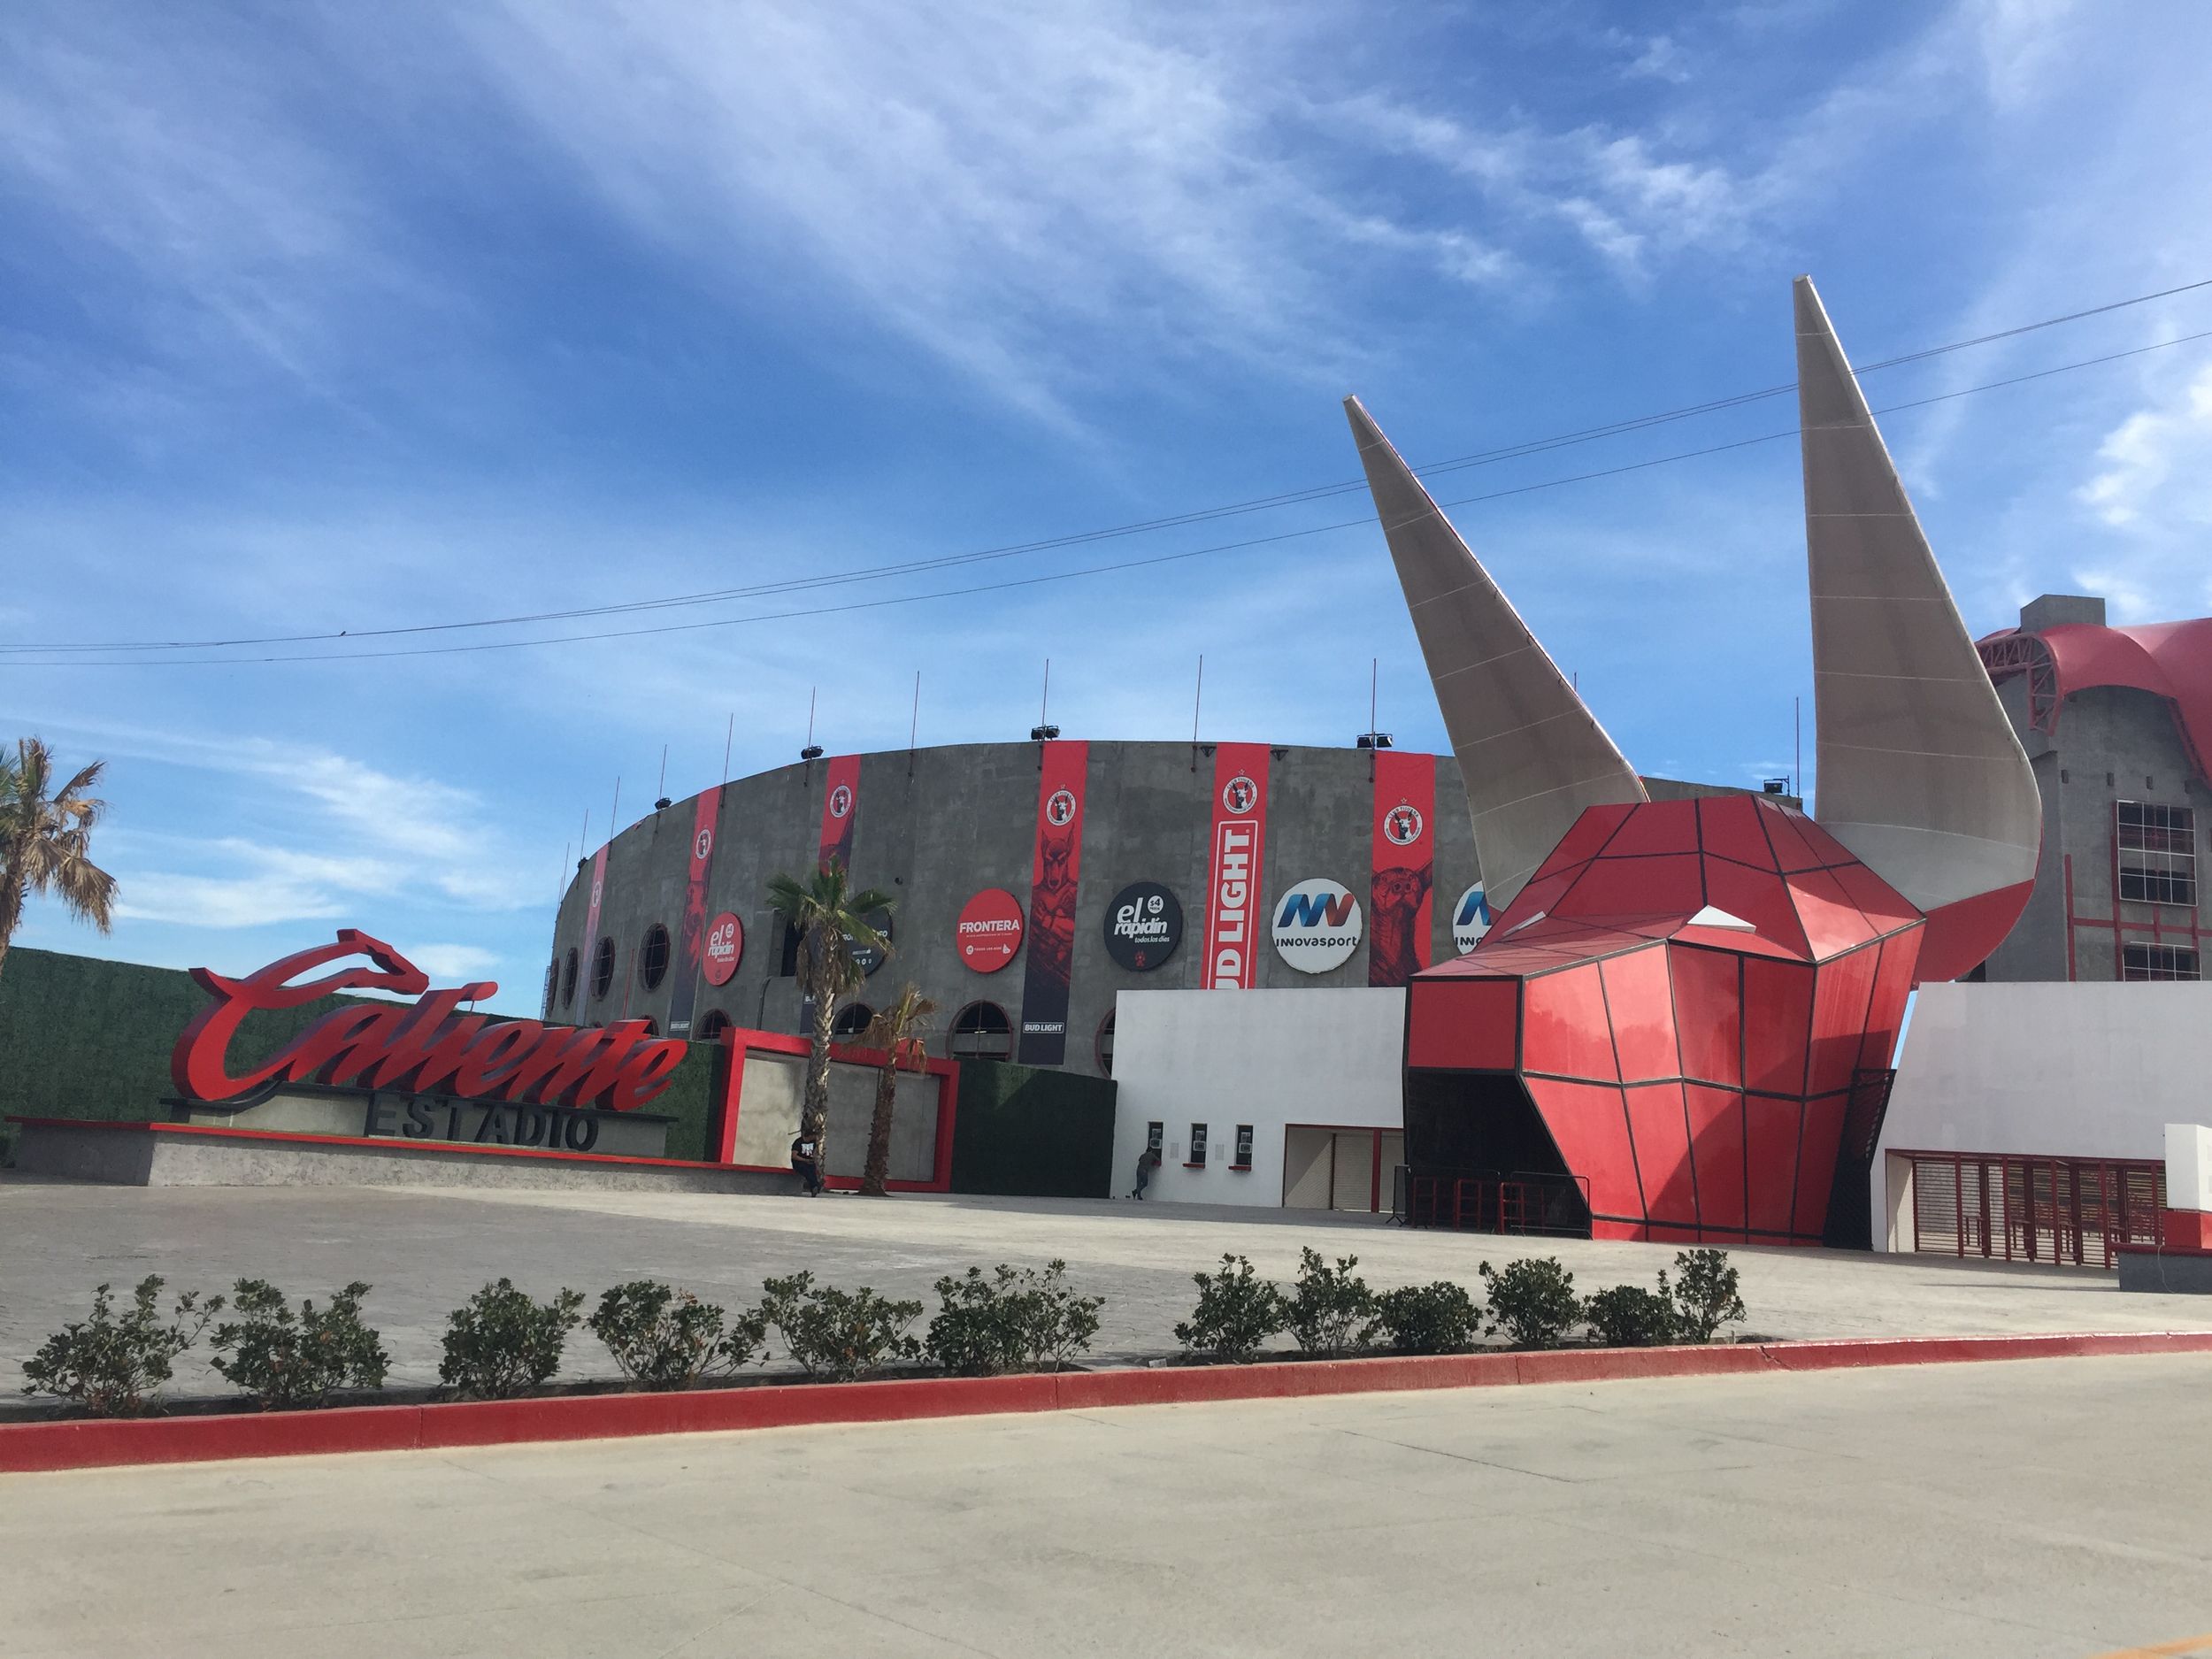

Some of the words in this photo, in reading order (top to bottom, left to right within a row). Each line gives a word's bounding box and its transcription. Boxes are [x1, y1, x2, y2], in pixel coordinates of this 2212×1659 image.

[1218, 829, 1250, 942] LIGHT
[1117, 897, 1144, 923] el
[710, 925, 725, 946] el
[959, 919, 1020, 933] FRONTERA
[1114, 917, 1168, 938] rapidín
[171, 928, 687, 1111] Caliente
[364, 1094, 599, 1151] ESTADIO
